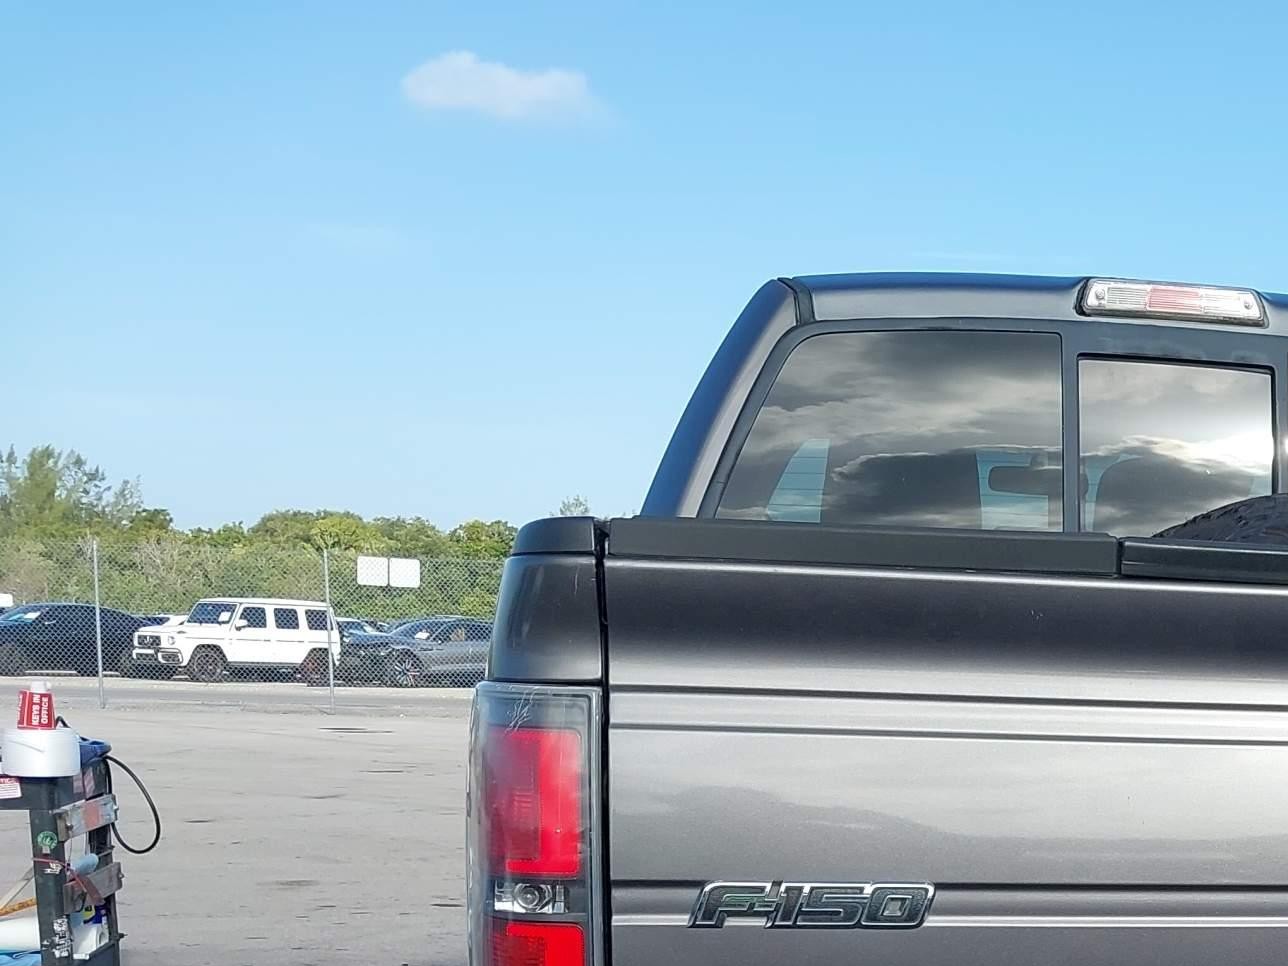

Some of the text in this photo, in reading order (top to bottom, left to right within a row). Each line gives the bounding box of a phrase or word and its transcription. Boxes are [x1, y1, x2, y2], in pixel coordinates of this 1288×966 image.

[32, 694, 41, 725] KEYS IN
[41, 697, 49, 724] OFFICE
[688, 881, 935, 928] F-150
